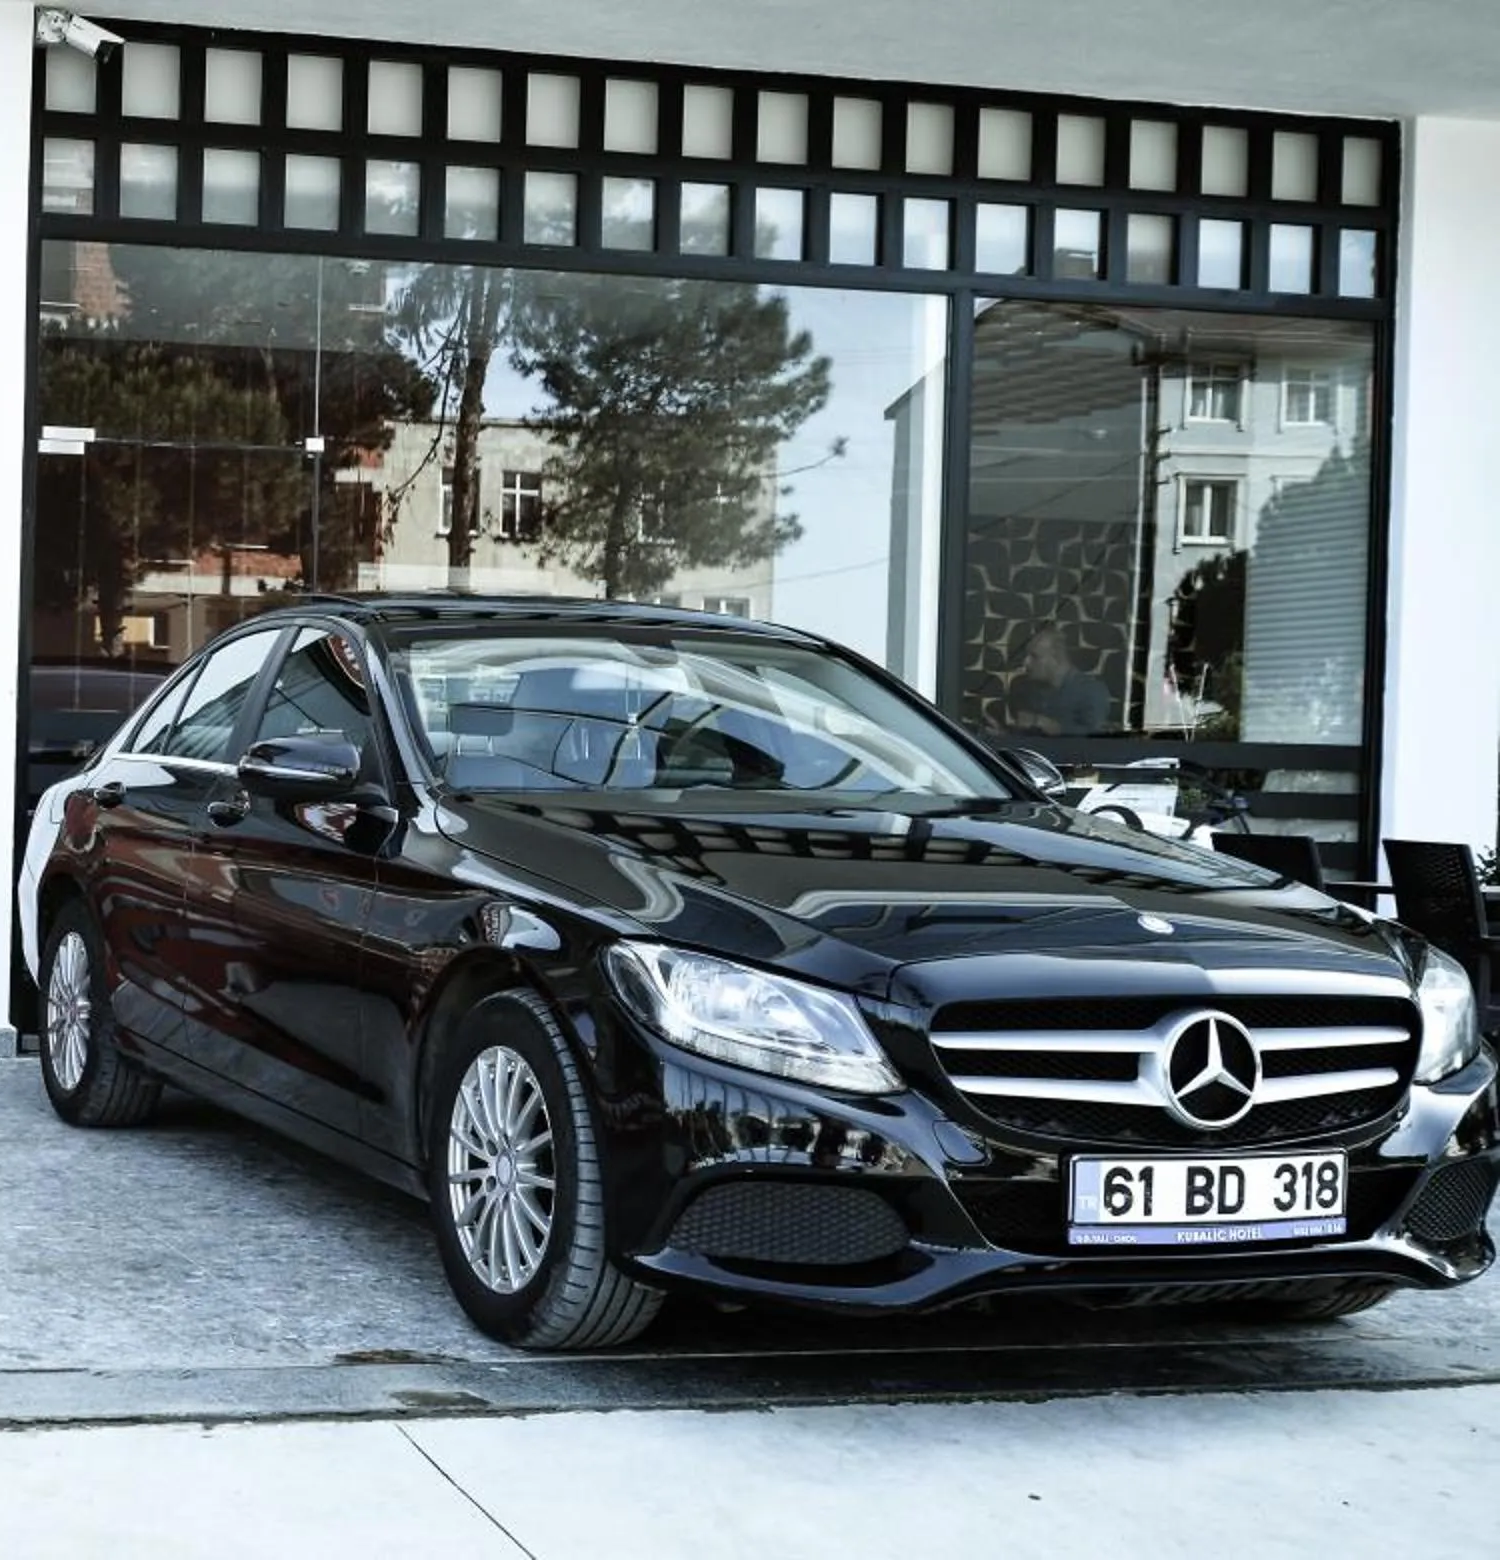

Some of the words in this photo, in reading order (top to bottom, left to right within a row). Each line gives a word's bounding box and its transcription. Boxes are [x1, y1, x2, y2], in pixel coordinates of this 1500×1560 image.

[1104, 1166, 1154, 1216] 61
[1185, 1165, 1245, 1216] BD
[1273, 1161, 1339, 1212] 318
[1229, 1226, 1263, 1241] HOTEL
